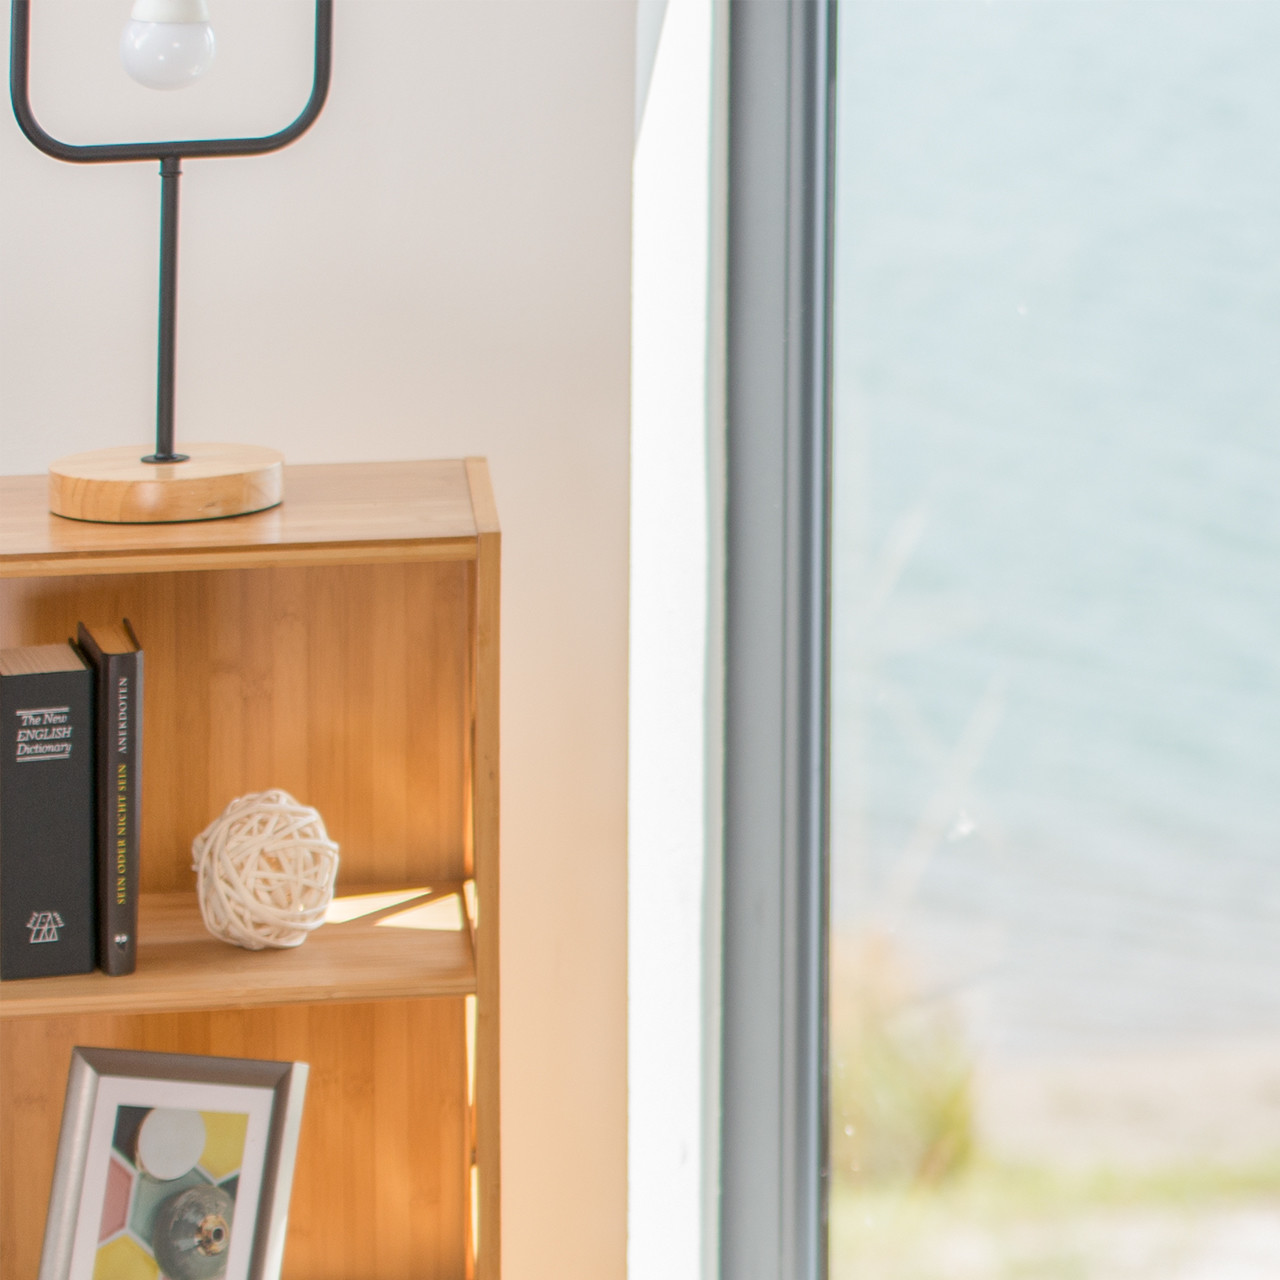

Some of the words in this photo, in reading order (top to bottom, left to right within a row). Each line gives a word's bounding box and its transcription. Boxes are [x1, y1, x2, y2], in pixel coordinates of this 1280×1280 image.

[22, 715, 41, 726] The
[44, 713, 68, 725] New
[118, 677, 128, 754] ANEKDOTEN
[16, 726, 73, 742] ENGLISH
[16, 742, 72, 756] Dictionary
[117, 764, 127, 792] SEIN
[117, 795, 127, 836] NICHT
[117, 839, 127, 874] ODER
[117, 876, 127, 905] SEIN
